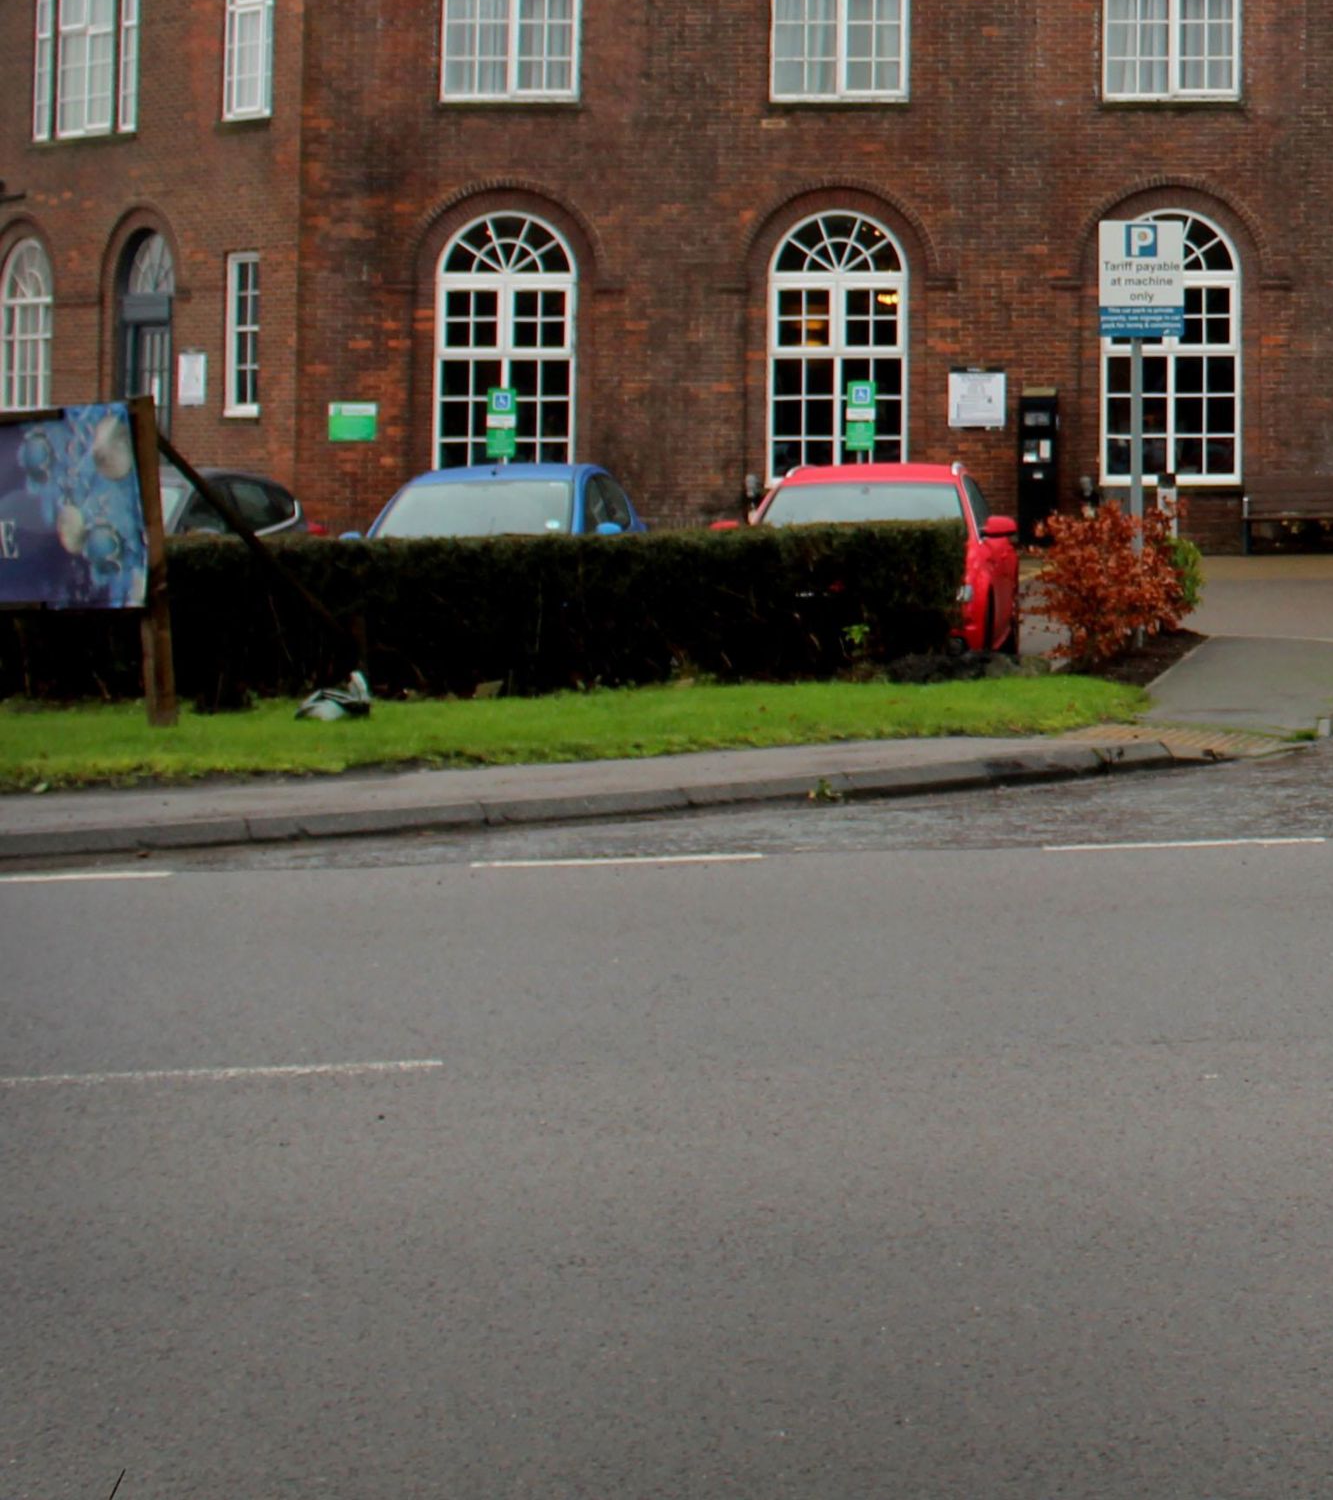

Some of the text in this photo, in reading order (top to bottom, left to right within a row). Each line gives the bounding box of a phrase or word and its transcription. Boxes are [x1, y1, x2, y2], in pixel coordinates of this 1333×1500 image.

[1130, 226, 1154, 256] P
[1103, 261, 1180, 273] Tariff payable
[1110, 276, 1173, 286] at machine
[1130, 292, 1154, 304] only
